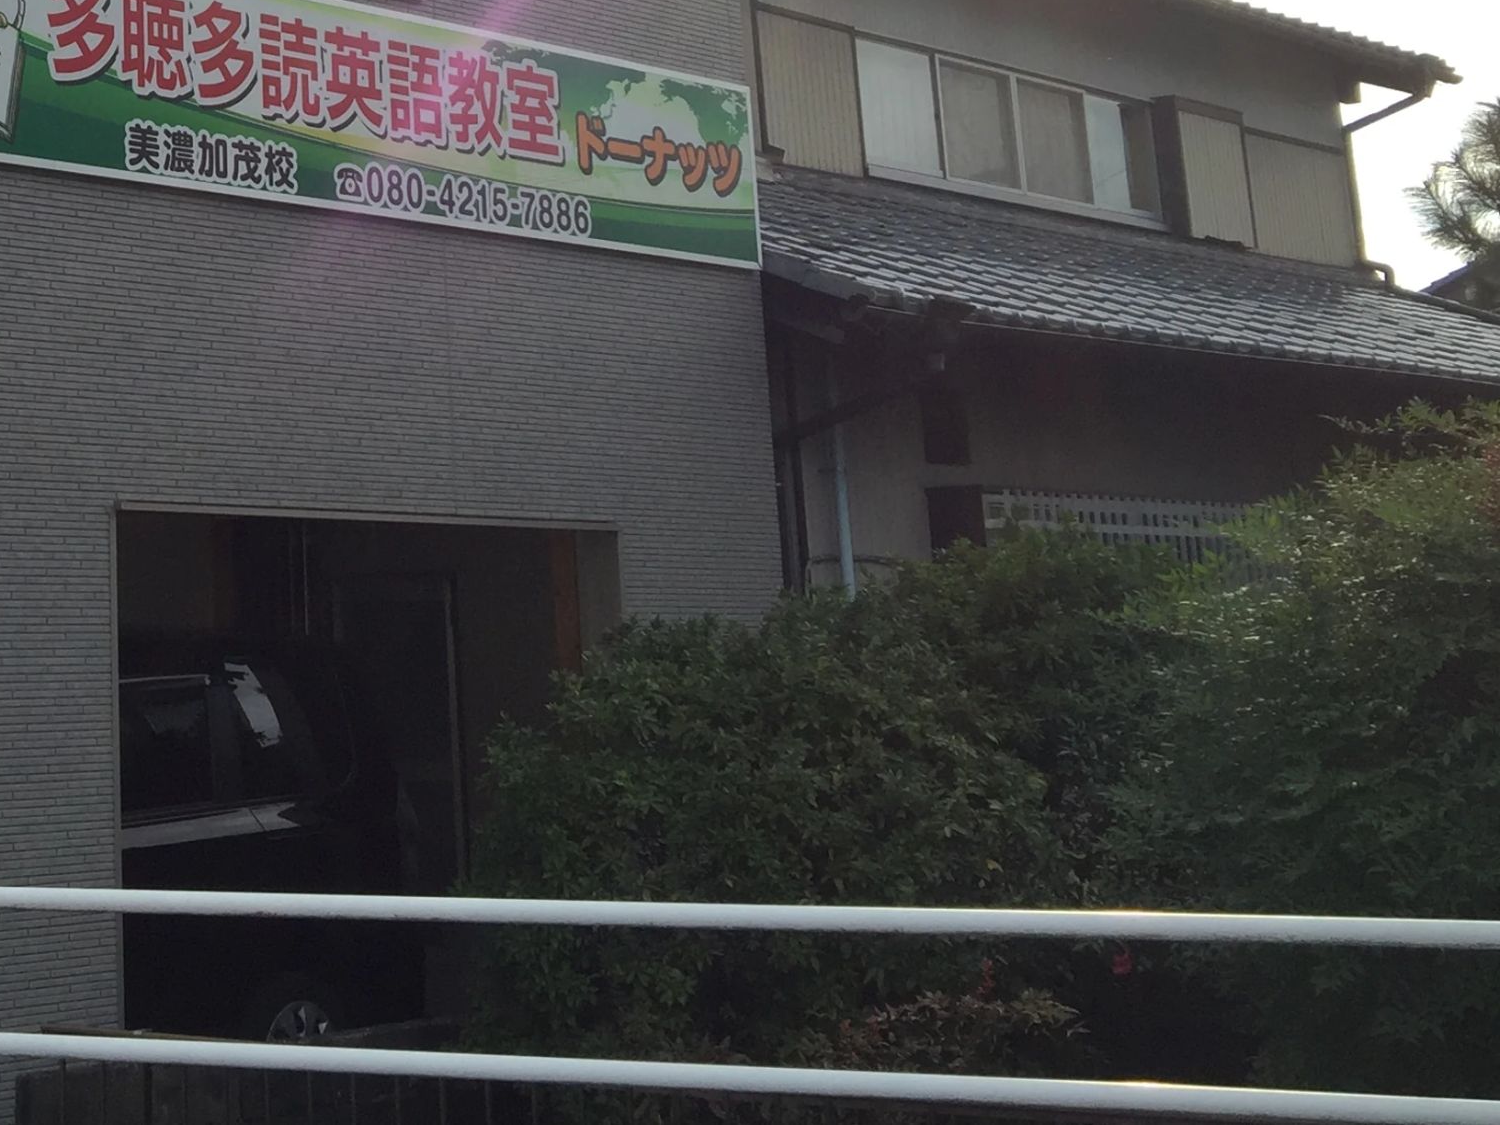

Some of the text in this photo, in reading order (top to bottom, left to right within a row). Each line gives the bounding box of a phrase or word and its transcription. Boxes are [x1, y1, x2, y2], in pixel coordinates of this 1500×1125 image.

[127, 124, 297, 191] 美濃加茂校
[576, 111, 741, 197] ドーナッツ
[366, 167, 591, 236] 080-4215-7886
